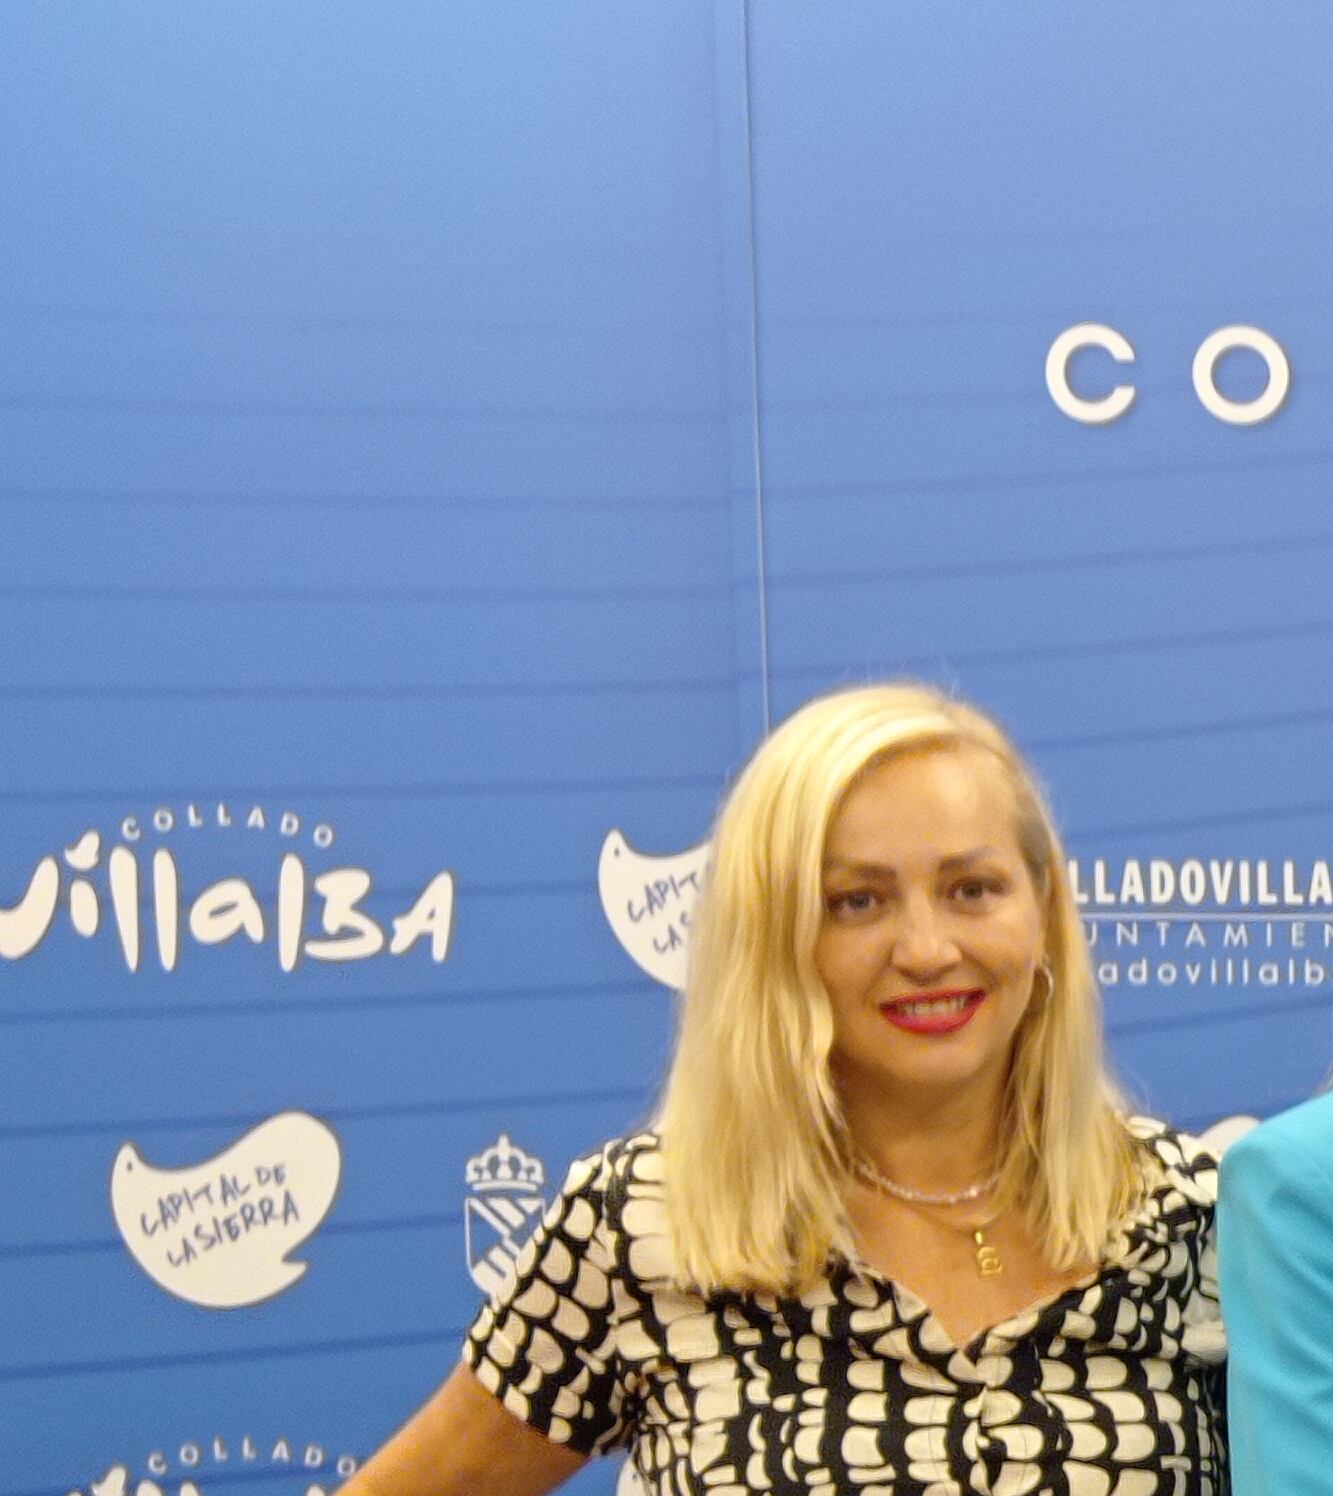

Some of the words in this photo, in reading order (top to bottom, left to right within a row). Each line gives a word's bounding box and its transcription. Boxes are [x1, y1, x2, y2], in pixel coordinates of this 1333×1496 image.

[122, 804, 334, 846] COLLADO
[628, 870, 704, 923] CAPIT
[141, 1173, 252, 1237] CAPITAL
[255, 1163, 286, 1187] DE
[167, 1237, 198, 1268] LA
[194, 1189, 300, 1252] SIERRA
[147, 1436, 359, 1478] COLLADO
